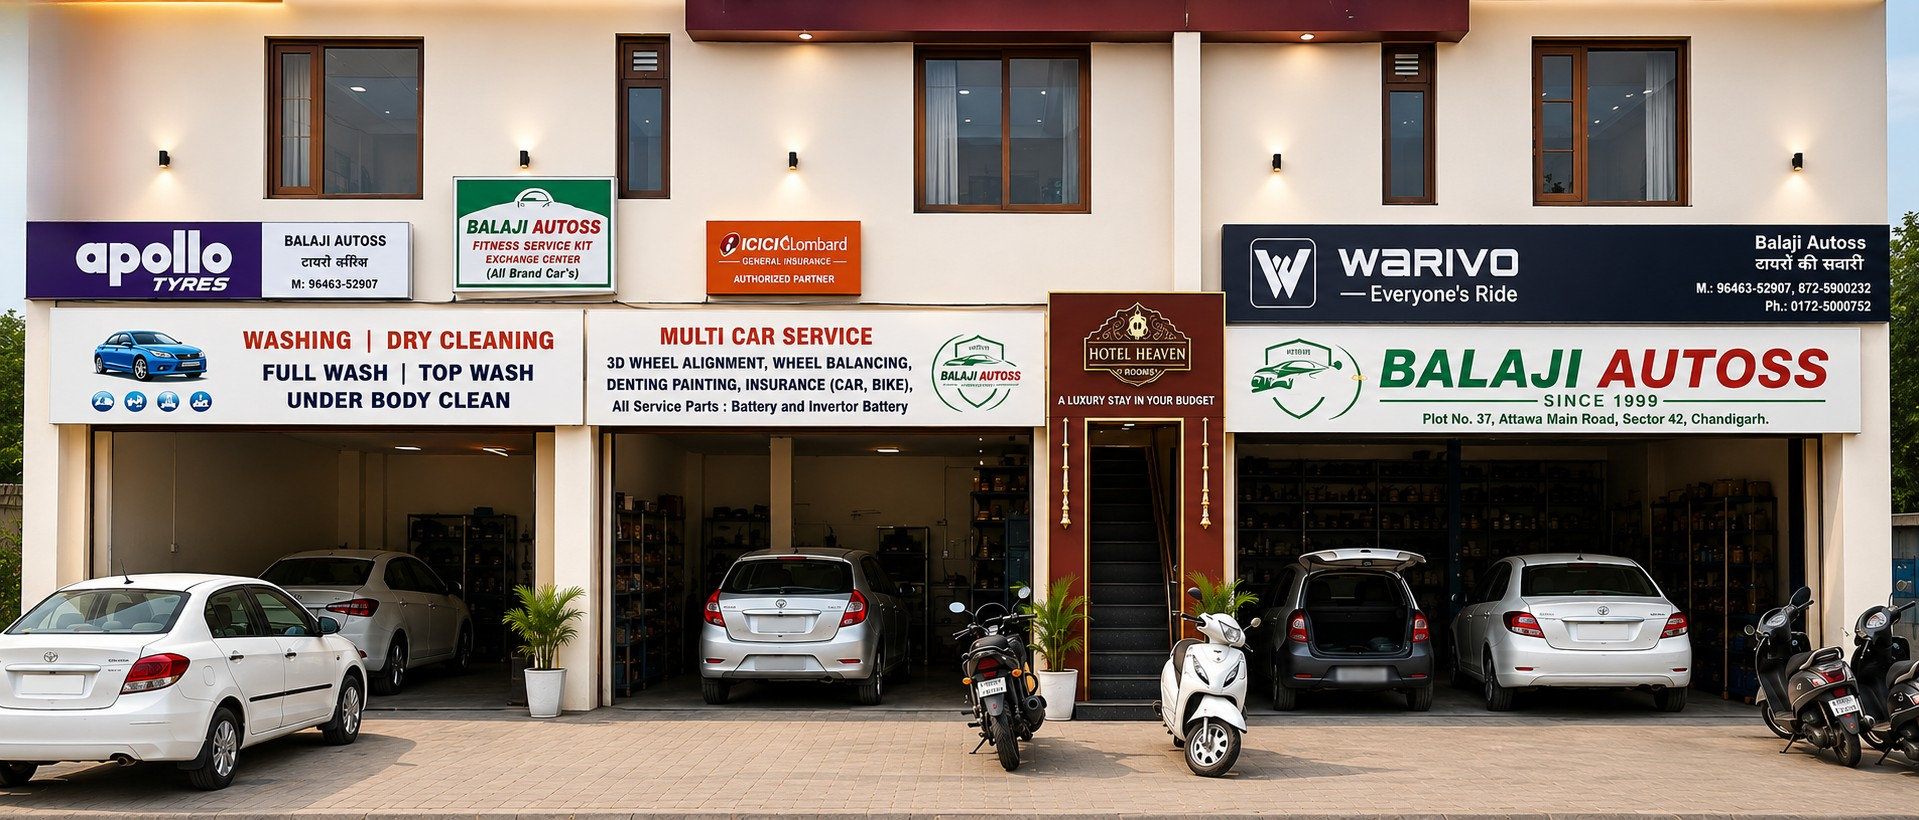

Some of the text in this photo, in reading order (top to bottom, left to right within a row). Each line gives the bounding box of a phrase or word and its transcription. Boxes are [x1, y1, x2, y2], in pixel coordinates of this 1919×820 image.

[467, 220, 601, 234] BALAJI AUTOSS
[285, 235, 386, 246] BALAJI AUTOSS
[473, 241, 593, 250] FITNESS SERVICE KIT
[791, 237, 847, 250] Lombard
[1756, 235, 1866, 253] Balaji Autoss
[75, 230, 233, 287] apollo
[486, 255, 580, 263] EXCHANGE CENTER
[743, 257, 781, 265] GENERAL
[1755, 253, 1793, 270] टायरों
[1798, 254, 1818, 270] की
[487, 268, 578, 280] (All Brand Car's)
[734, 275, 834, 283] AUTHORIZED PARTNER
[154, 277, 230, 291] TYRES
[292, 279, 378, 288] M: 96463-52907
[1697, 283, 1870, 295] M.: 96463-52907, 872-5900232
[1372, 285, 1517, 306] Everyone's Ride
[1766, 300, 1870, 311] Ph.: 0172-5000752
[243, 331, 350, 349] WASHING
[388, 331, 432, 349] DRY
[440, 331, 553, 349] CLEANING
[661, 327, 872, 345] MULTI CAR SERVICE
[1090, 348, 1185, 360] HOTEL HEAVEN
[607, 357, 911, 371] 3D WHEEL ALIGNMENT, WHEEL BALANCING,
[1380, 348, 1828, 388] BALAJI AUTOSS
[263, 364, 316, 381] FULL
[324, 364, 387, 381] WASH
[419, 364, 462, 381] TOP
[470, 364, 533, 381] WASH
[941, 371, 1021, 381] BALAJI AUTOSS
[607, 379, 912, 393] DENTING PAINTING, INSURANCE (CAR, BIKE),
[288, 392, 509, 408] UNDER BODY CLEAN
[1058, 396, 1214, 405] A LUXURY STAY IN YOUR BUDGET
[1544, 394, 1657, 407] SINCE 1999
[613, 400, 629, 412] All
[634, 400, 681, 412] Service
[686, 401, 718, 412] Parts
[732, 401, 777, 415] Battery
[781, 400, 804, 412] and
[810, 401, 858, 412] Invertor
[863, 401, 908, 415] Battery
[1423, 413, 1768, 427] Plot No. 37, Attawa Main Road, Sector 42, Chandigarh.
